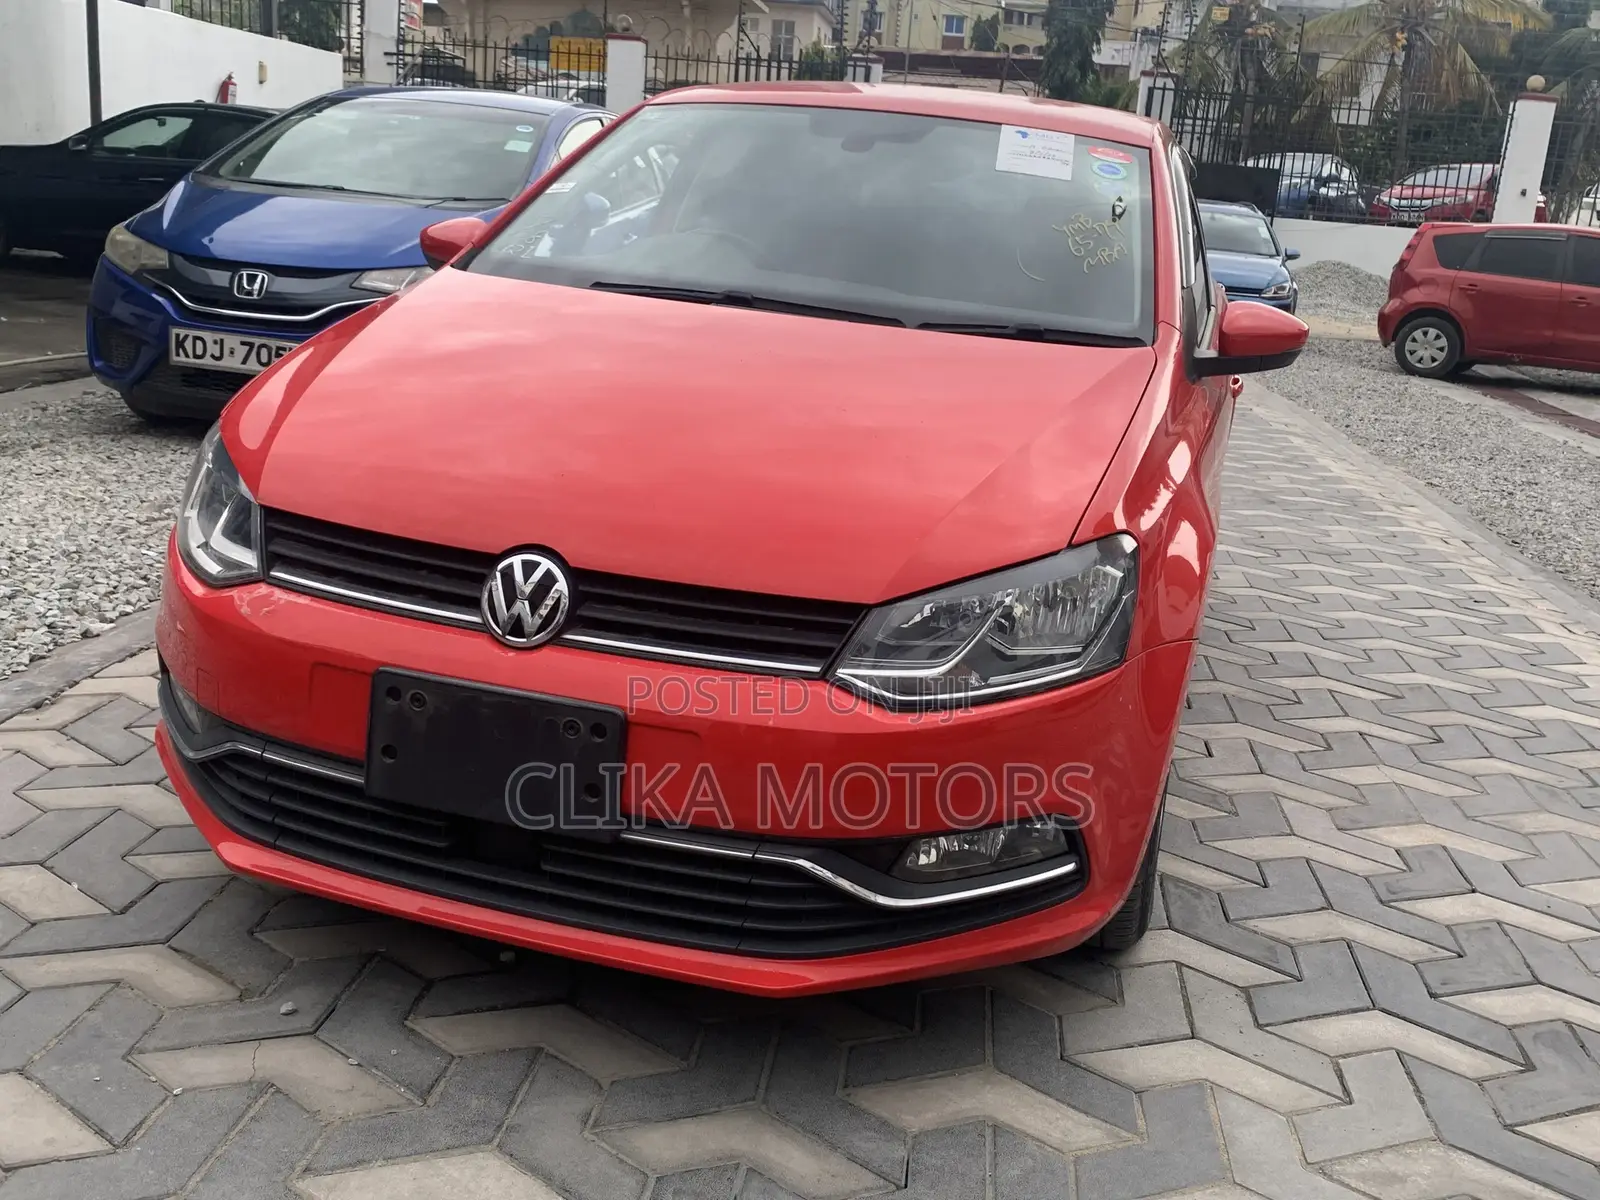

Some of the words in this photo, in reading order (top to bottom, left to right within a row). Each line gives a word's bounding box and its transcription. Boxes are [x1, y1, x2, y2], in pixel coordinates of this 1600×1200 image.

[174, 332, 225, 362] KDJ
[240, 340, 294, 368] 705
[483, 554, 567, 644] VW
